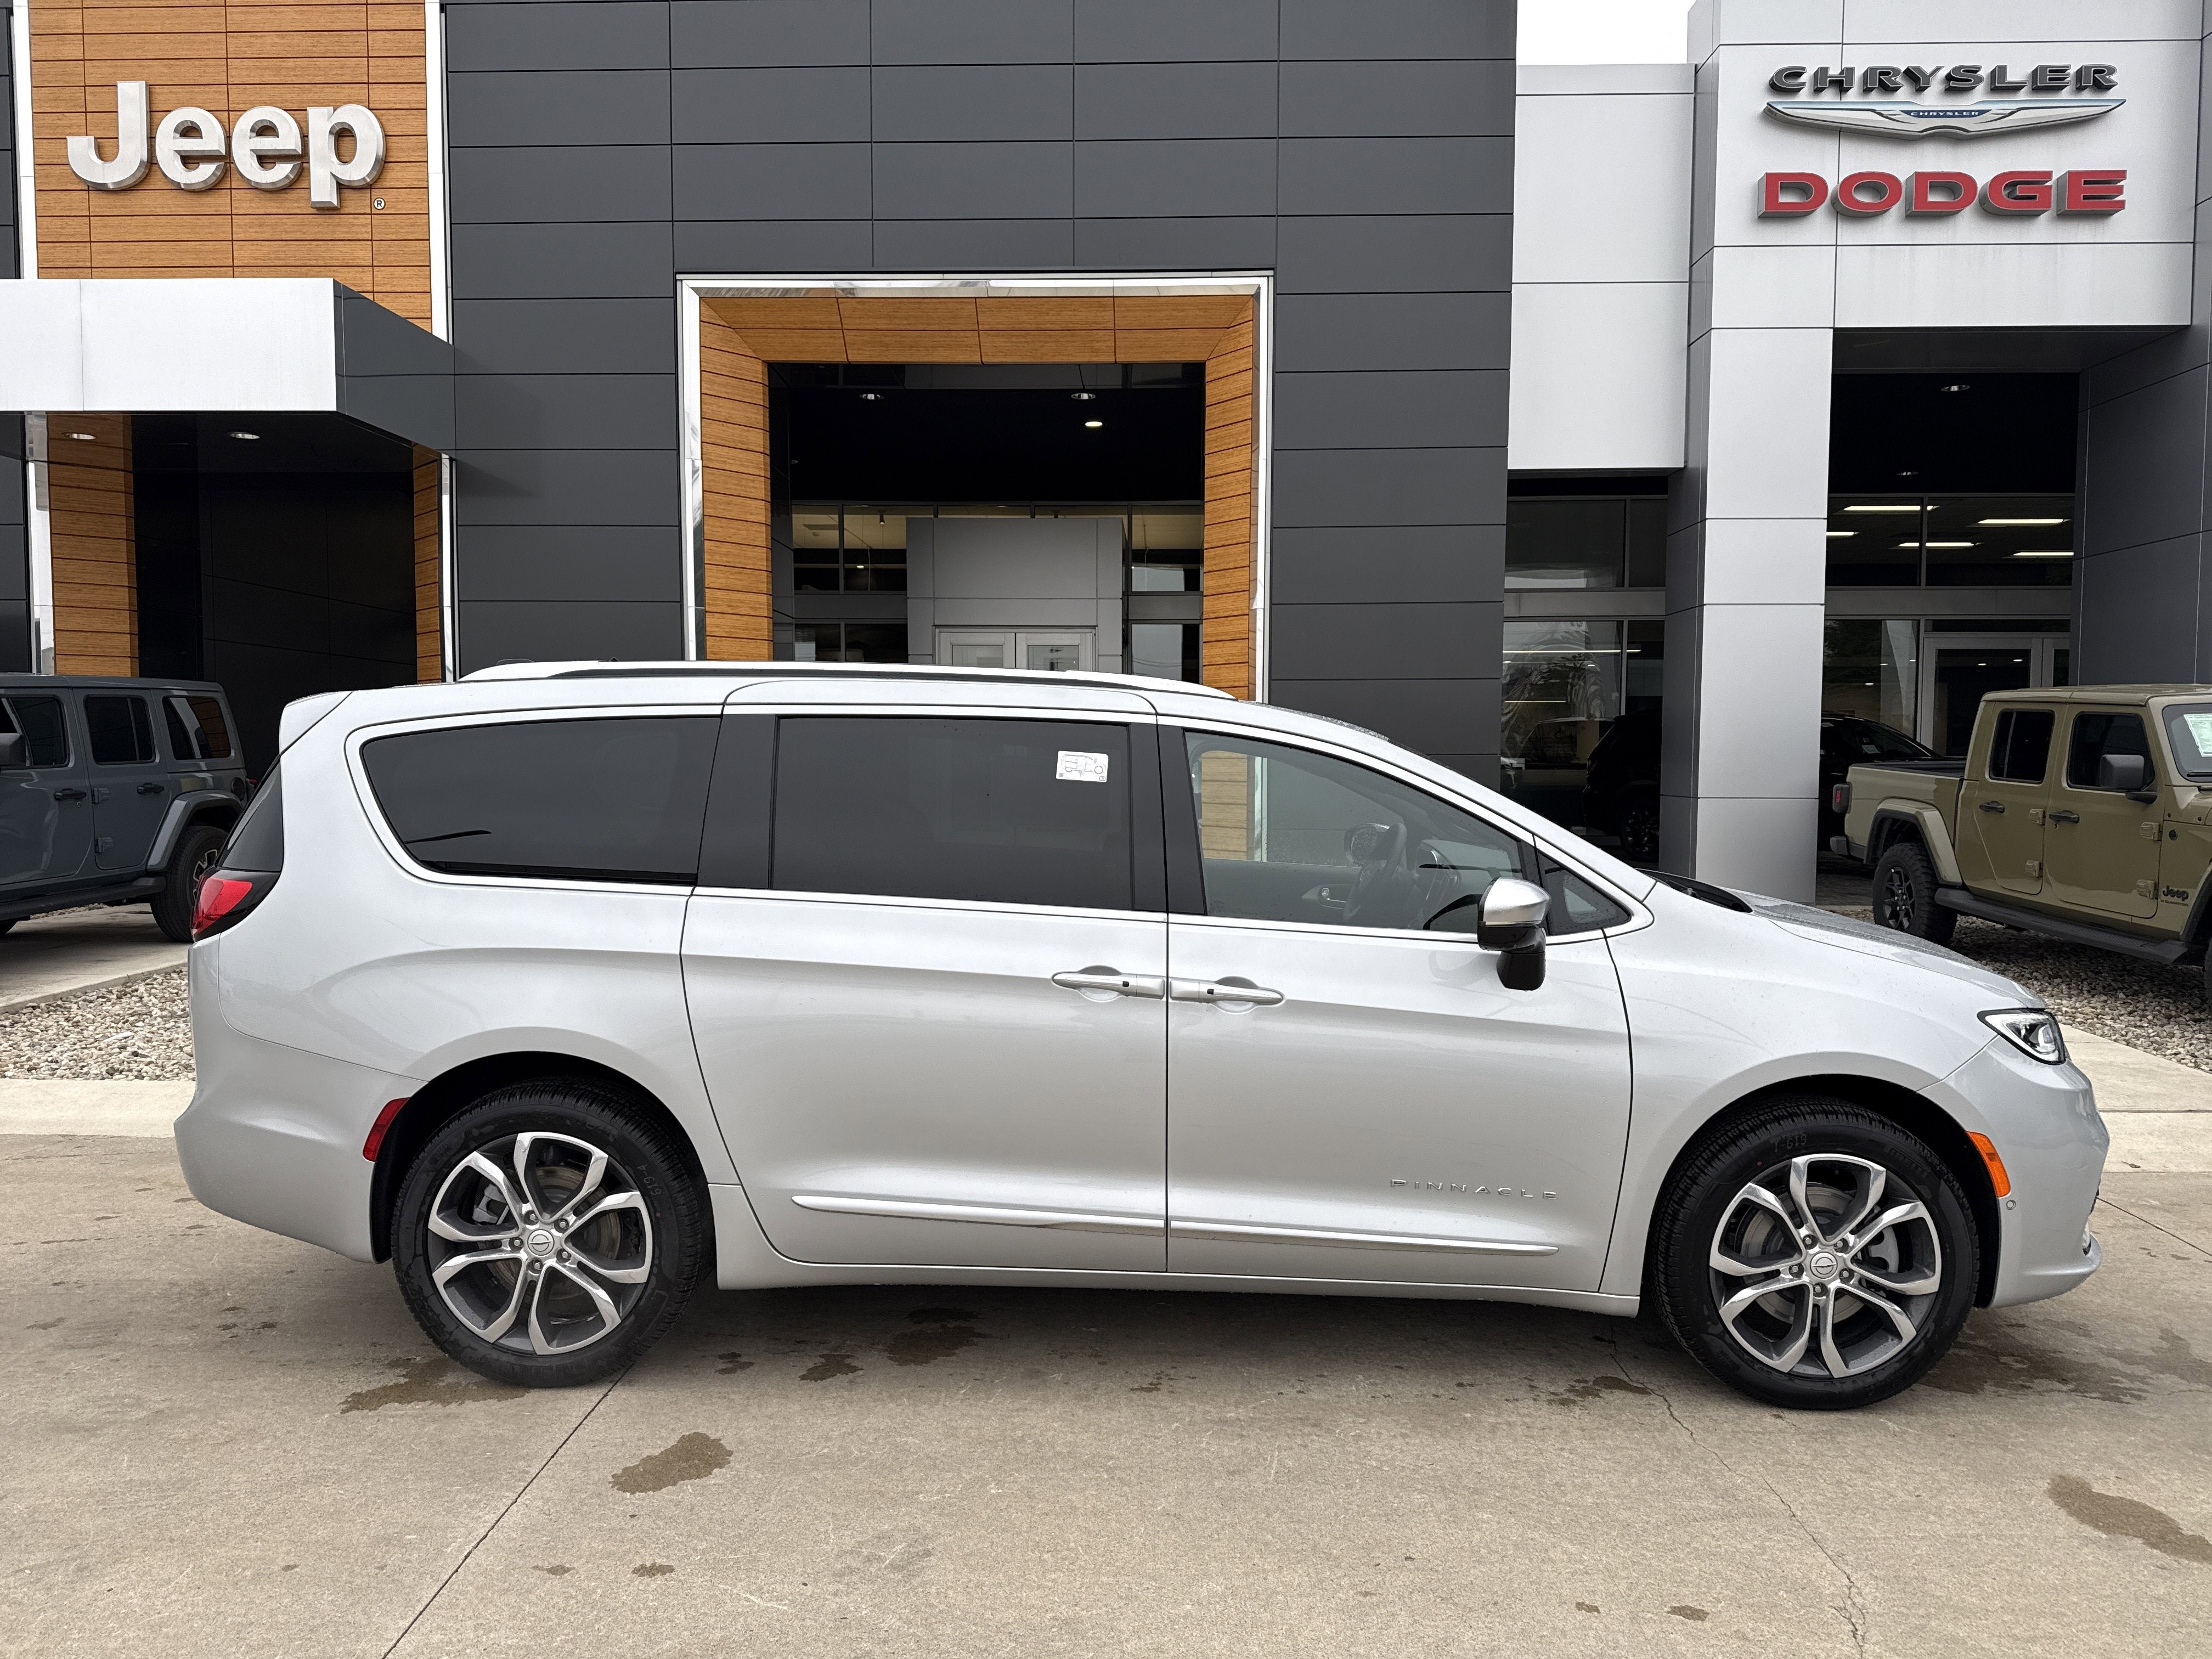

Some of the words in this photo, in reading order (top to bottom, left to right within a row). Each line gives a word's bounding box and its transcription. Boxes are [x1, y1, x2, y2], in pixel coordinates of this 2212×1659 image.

[1769, 64, 2119, 92] CHRYSLER
[66, 81, 386, 211] Jeep
[1758, 170, 2128, 218] DODGE
[2163, 885, 2189, 901] Jeep
[1390, 1179, 1557, 1200] PINNACLE
